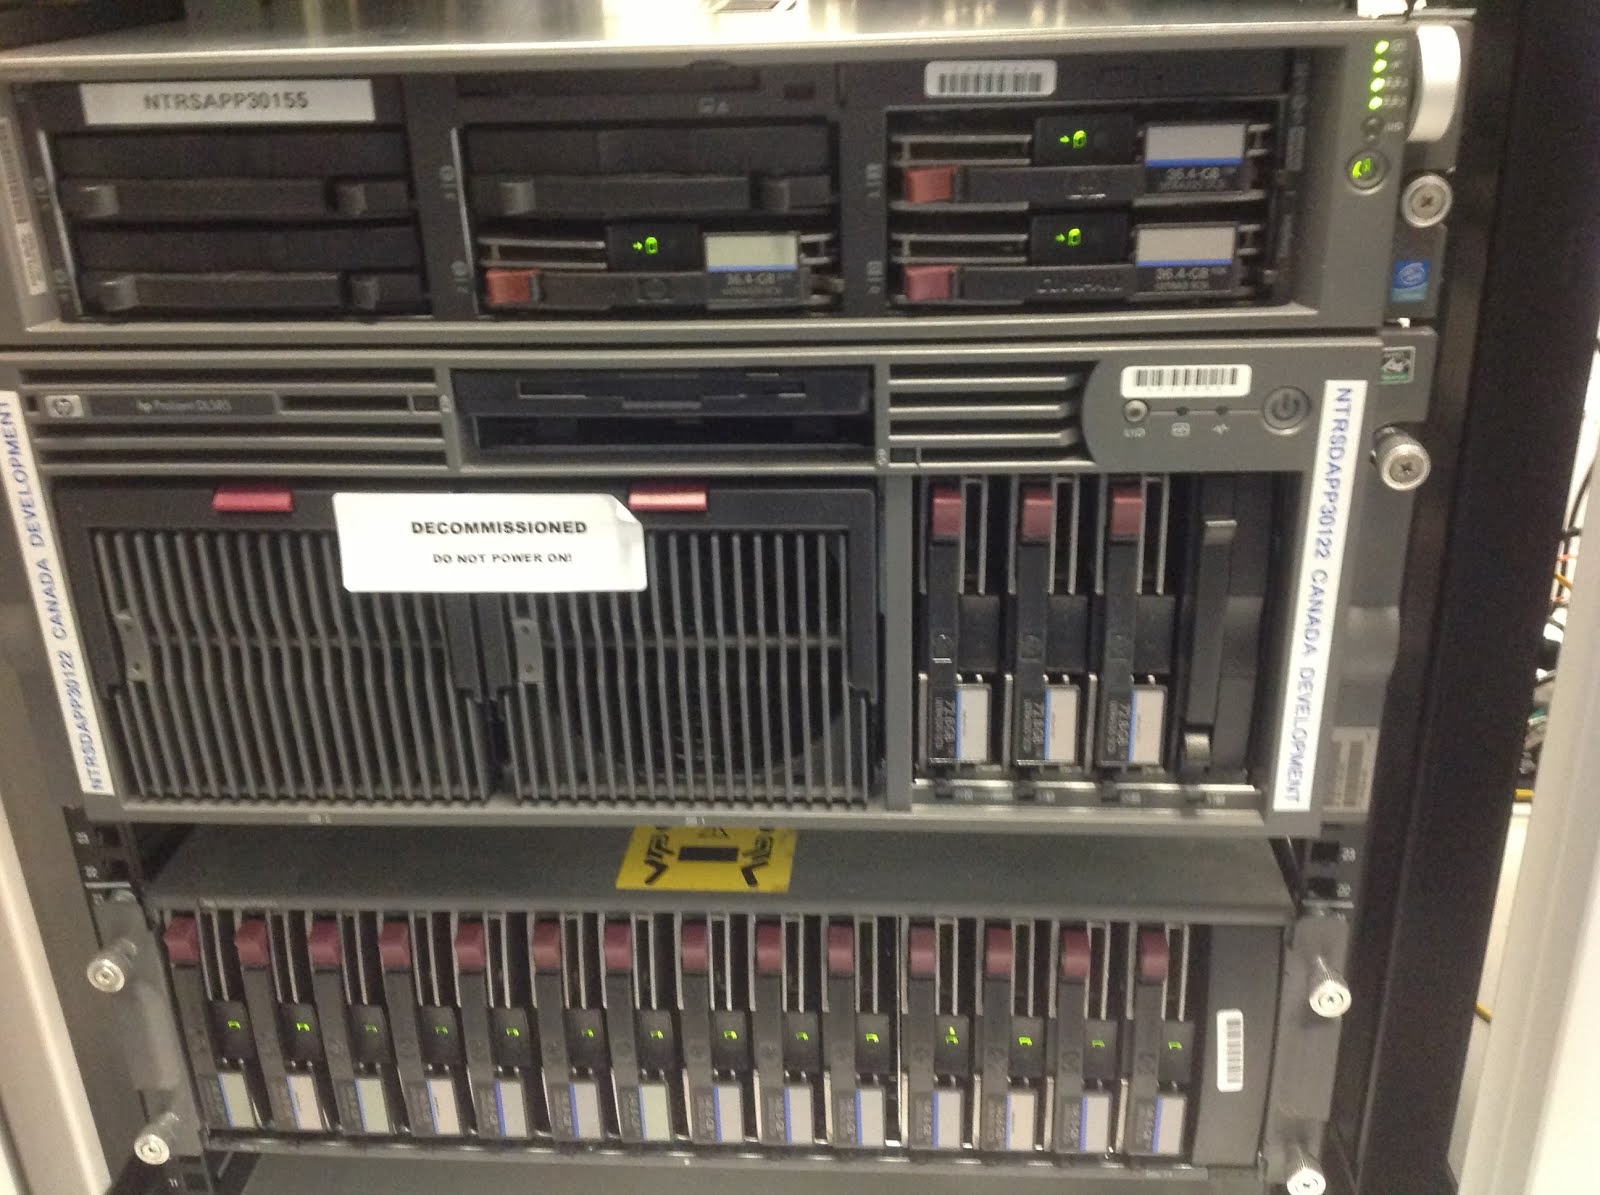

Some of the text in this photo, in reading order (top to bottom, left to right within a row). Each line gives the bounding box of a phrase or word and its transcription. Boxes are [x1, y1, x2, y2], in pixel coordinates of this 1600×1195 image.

[143, 91, 309, 111] NTRSAPP30155
[411, 521, 588, 535] DECOMMISSIONED
[432, 552, 573, 564] DO NOT POWER ON!
[36, 557, 68, 640] CANADA
[1302, 569, 1329, 656] CANADA
[1284, 667, 1315, 803] DEVELOPMENT
